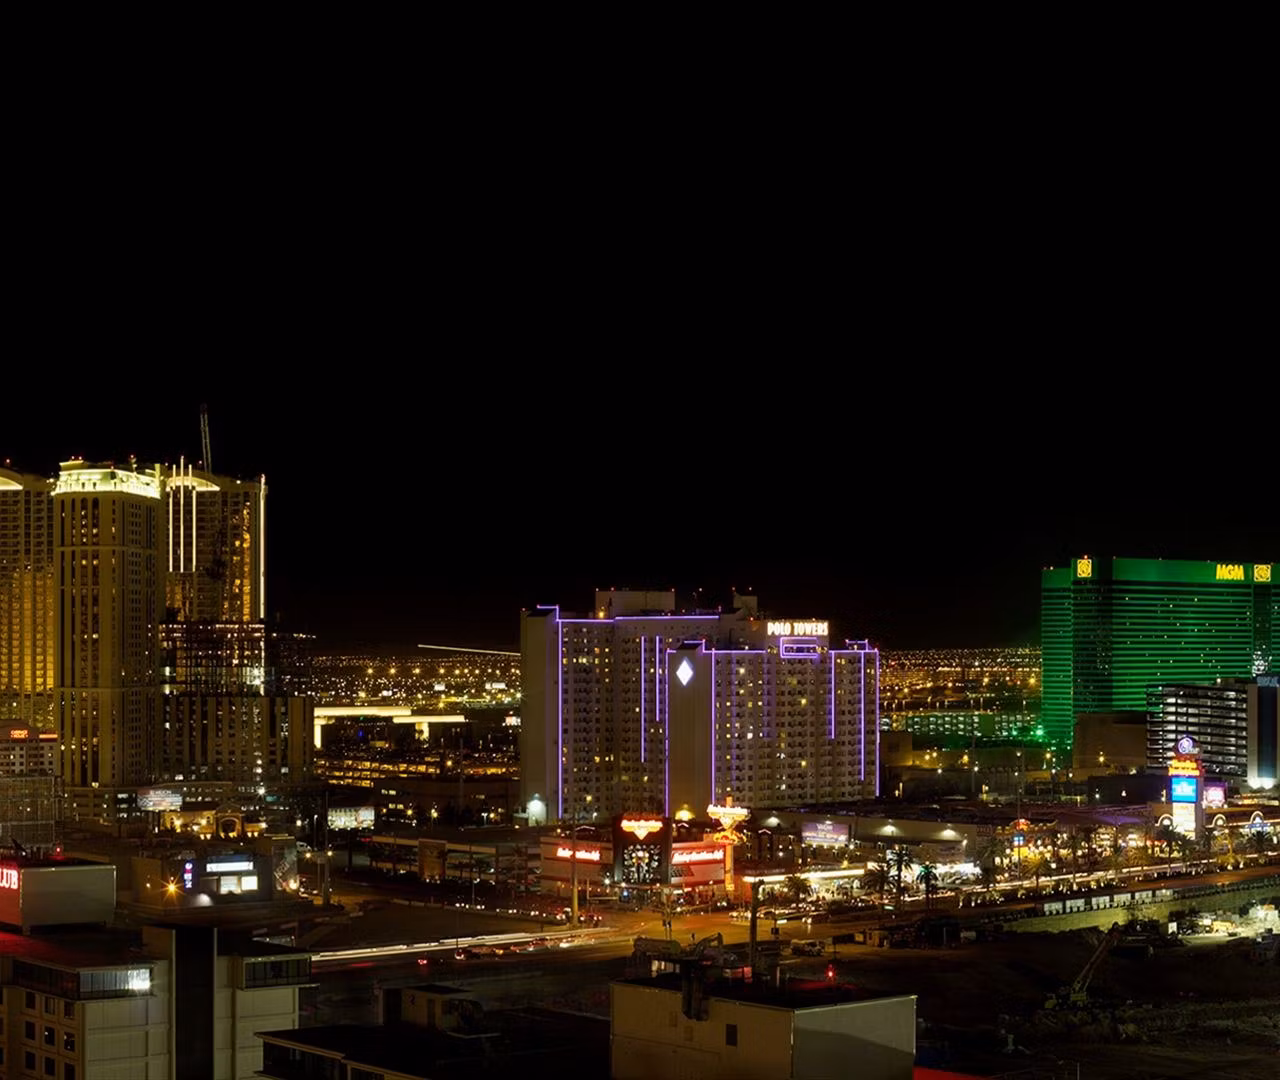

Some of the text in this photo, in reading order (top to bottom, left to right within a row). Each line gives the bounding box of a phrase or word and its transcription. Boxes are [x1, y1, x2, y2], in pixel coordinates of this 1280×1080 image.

[1216, 564, 1245, 581] MGM
[767, 622, 829, 636] POLO TOWERS
